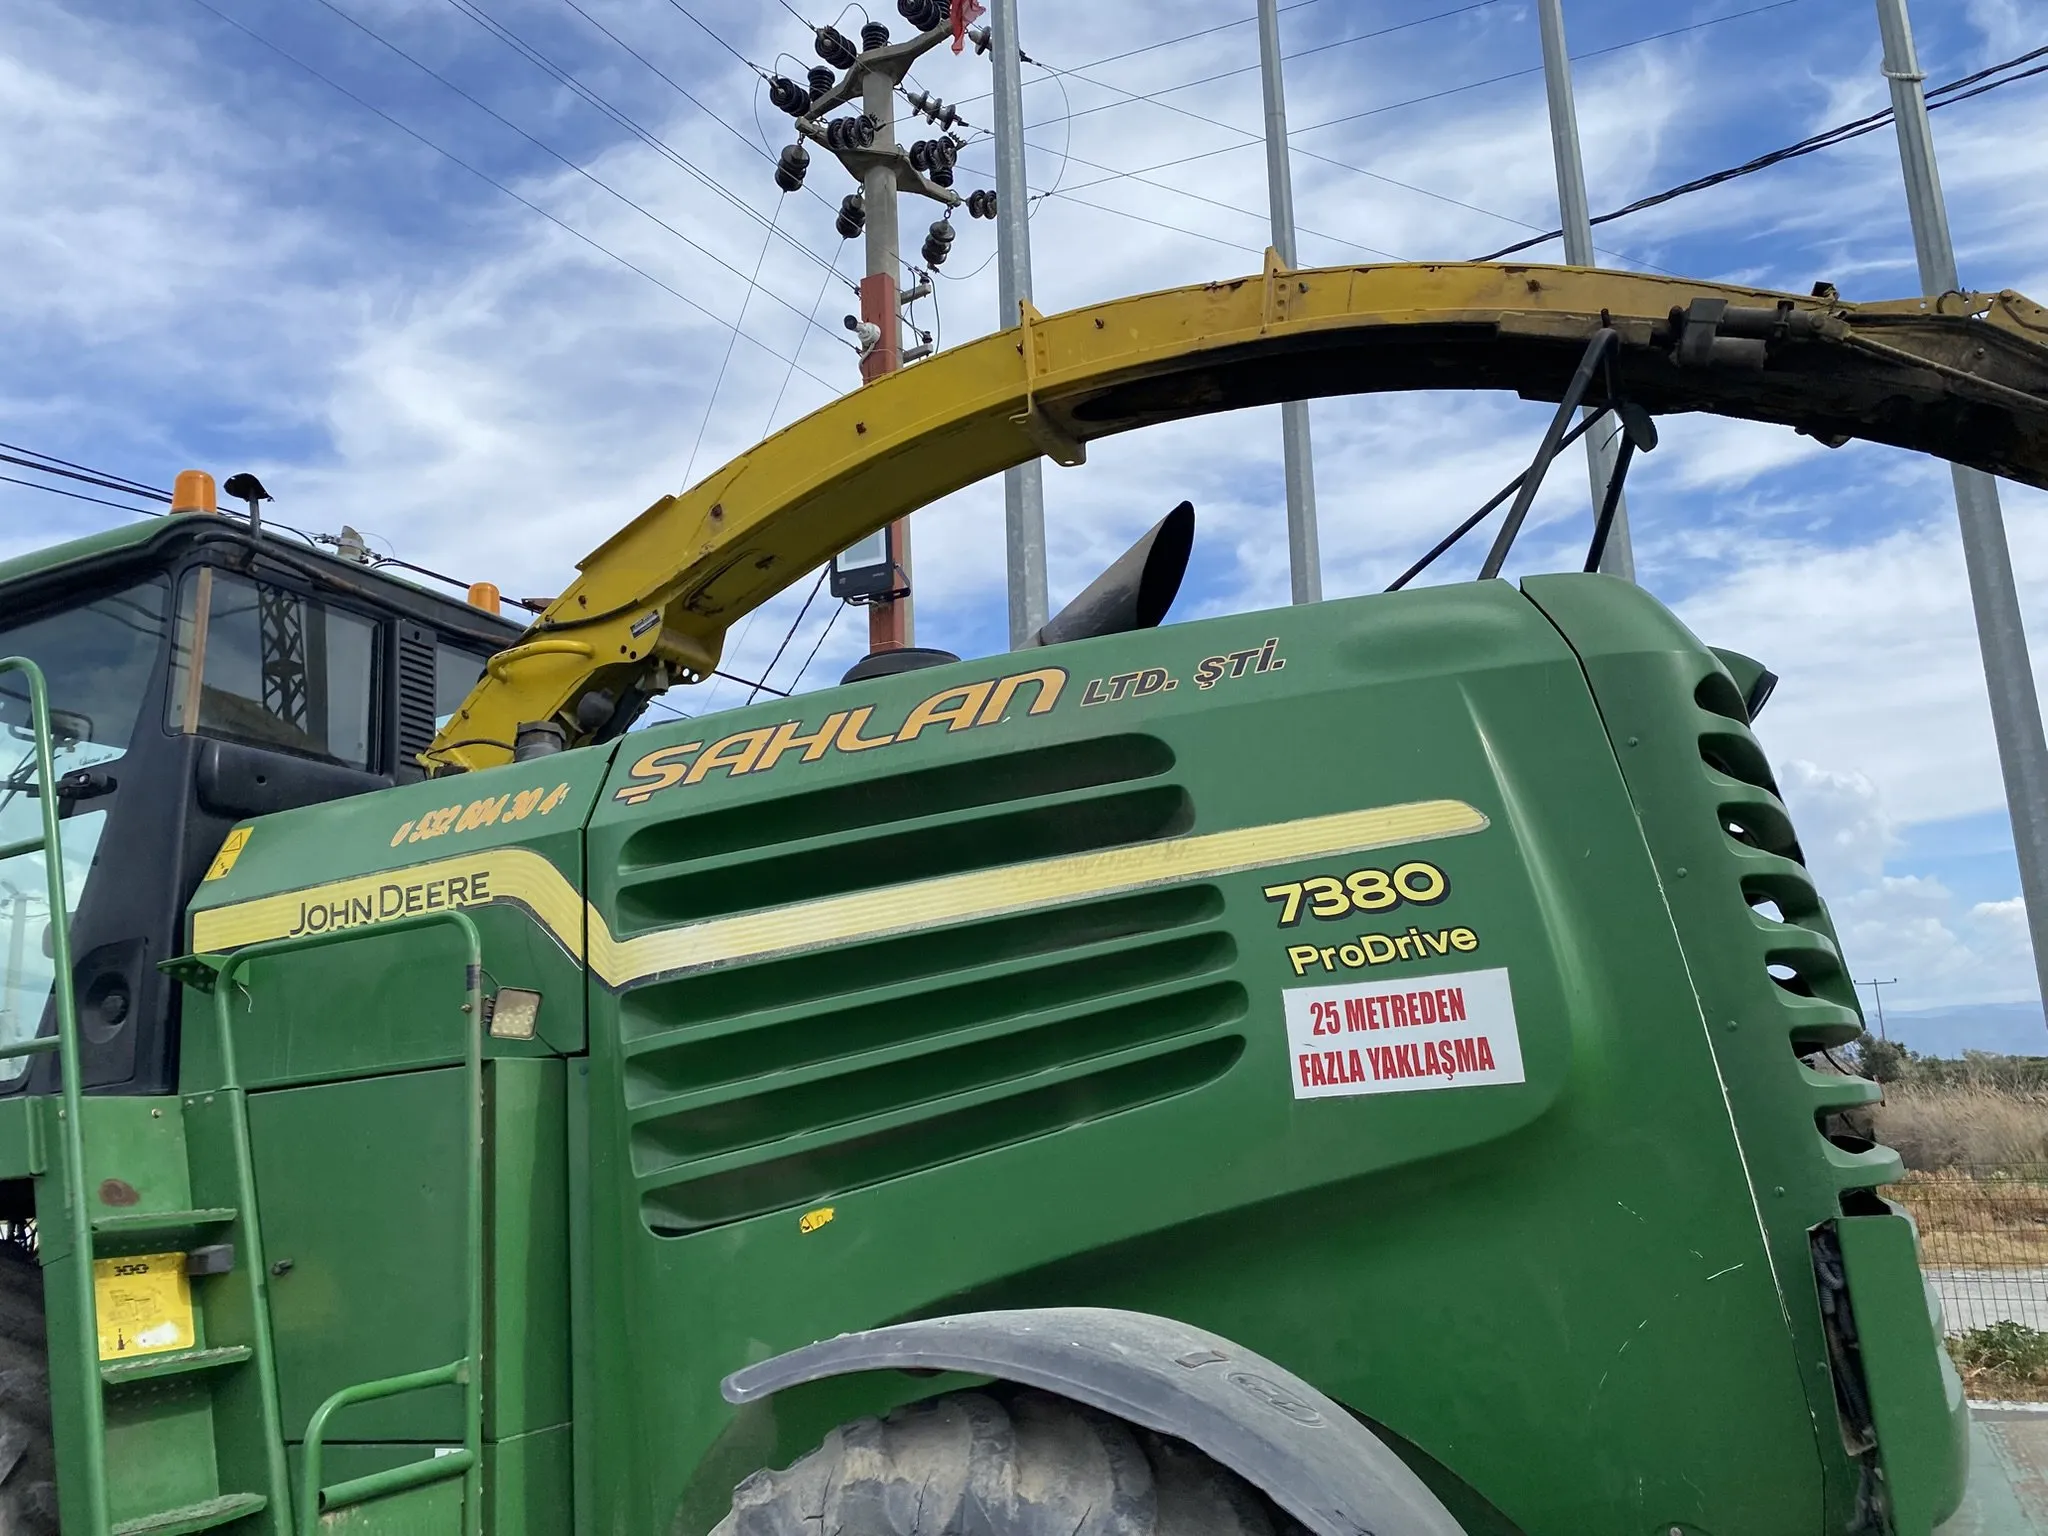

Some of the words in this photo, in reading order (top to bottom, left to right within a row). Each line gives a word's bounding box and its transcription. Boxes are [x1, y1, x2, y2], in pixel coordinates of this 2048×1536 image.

[612, 666, 1070, 806] ŞAHLAN
[1080, 667, 1179, 707] LTD.
[1194, 637, 1286, 690] ŞTİ.
[289, 894, 372, 936] JOHN
[379, 871, 490, 918] DEERE
[1262, 860, 1452, 929] 7380
[1286, 926, 1479, 977] ProDrive
[1310, 1001, 1341, 1036] 25
[1344, 987, 1467, 1032] METREDEN
[1299, 1049, 1366, 1088] FAZLA
[1366, 1036, 1496, 1081] YAKLAŞMA
